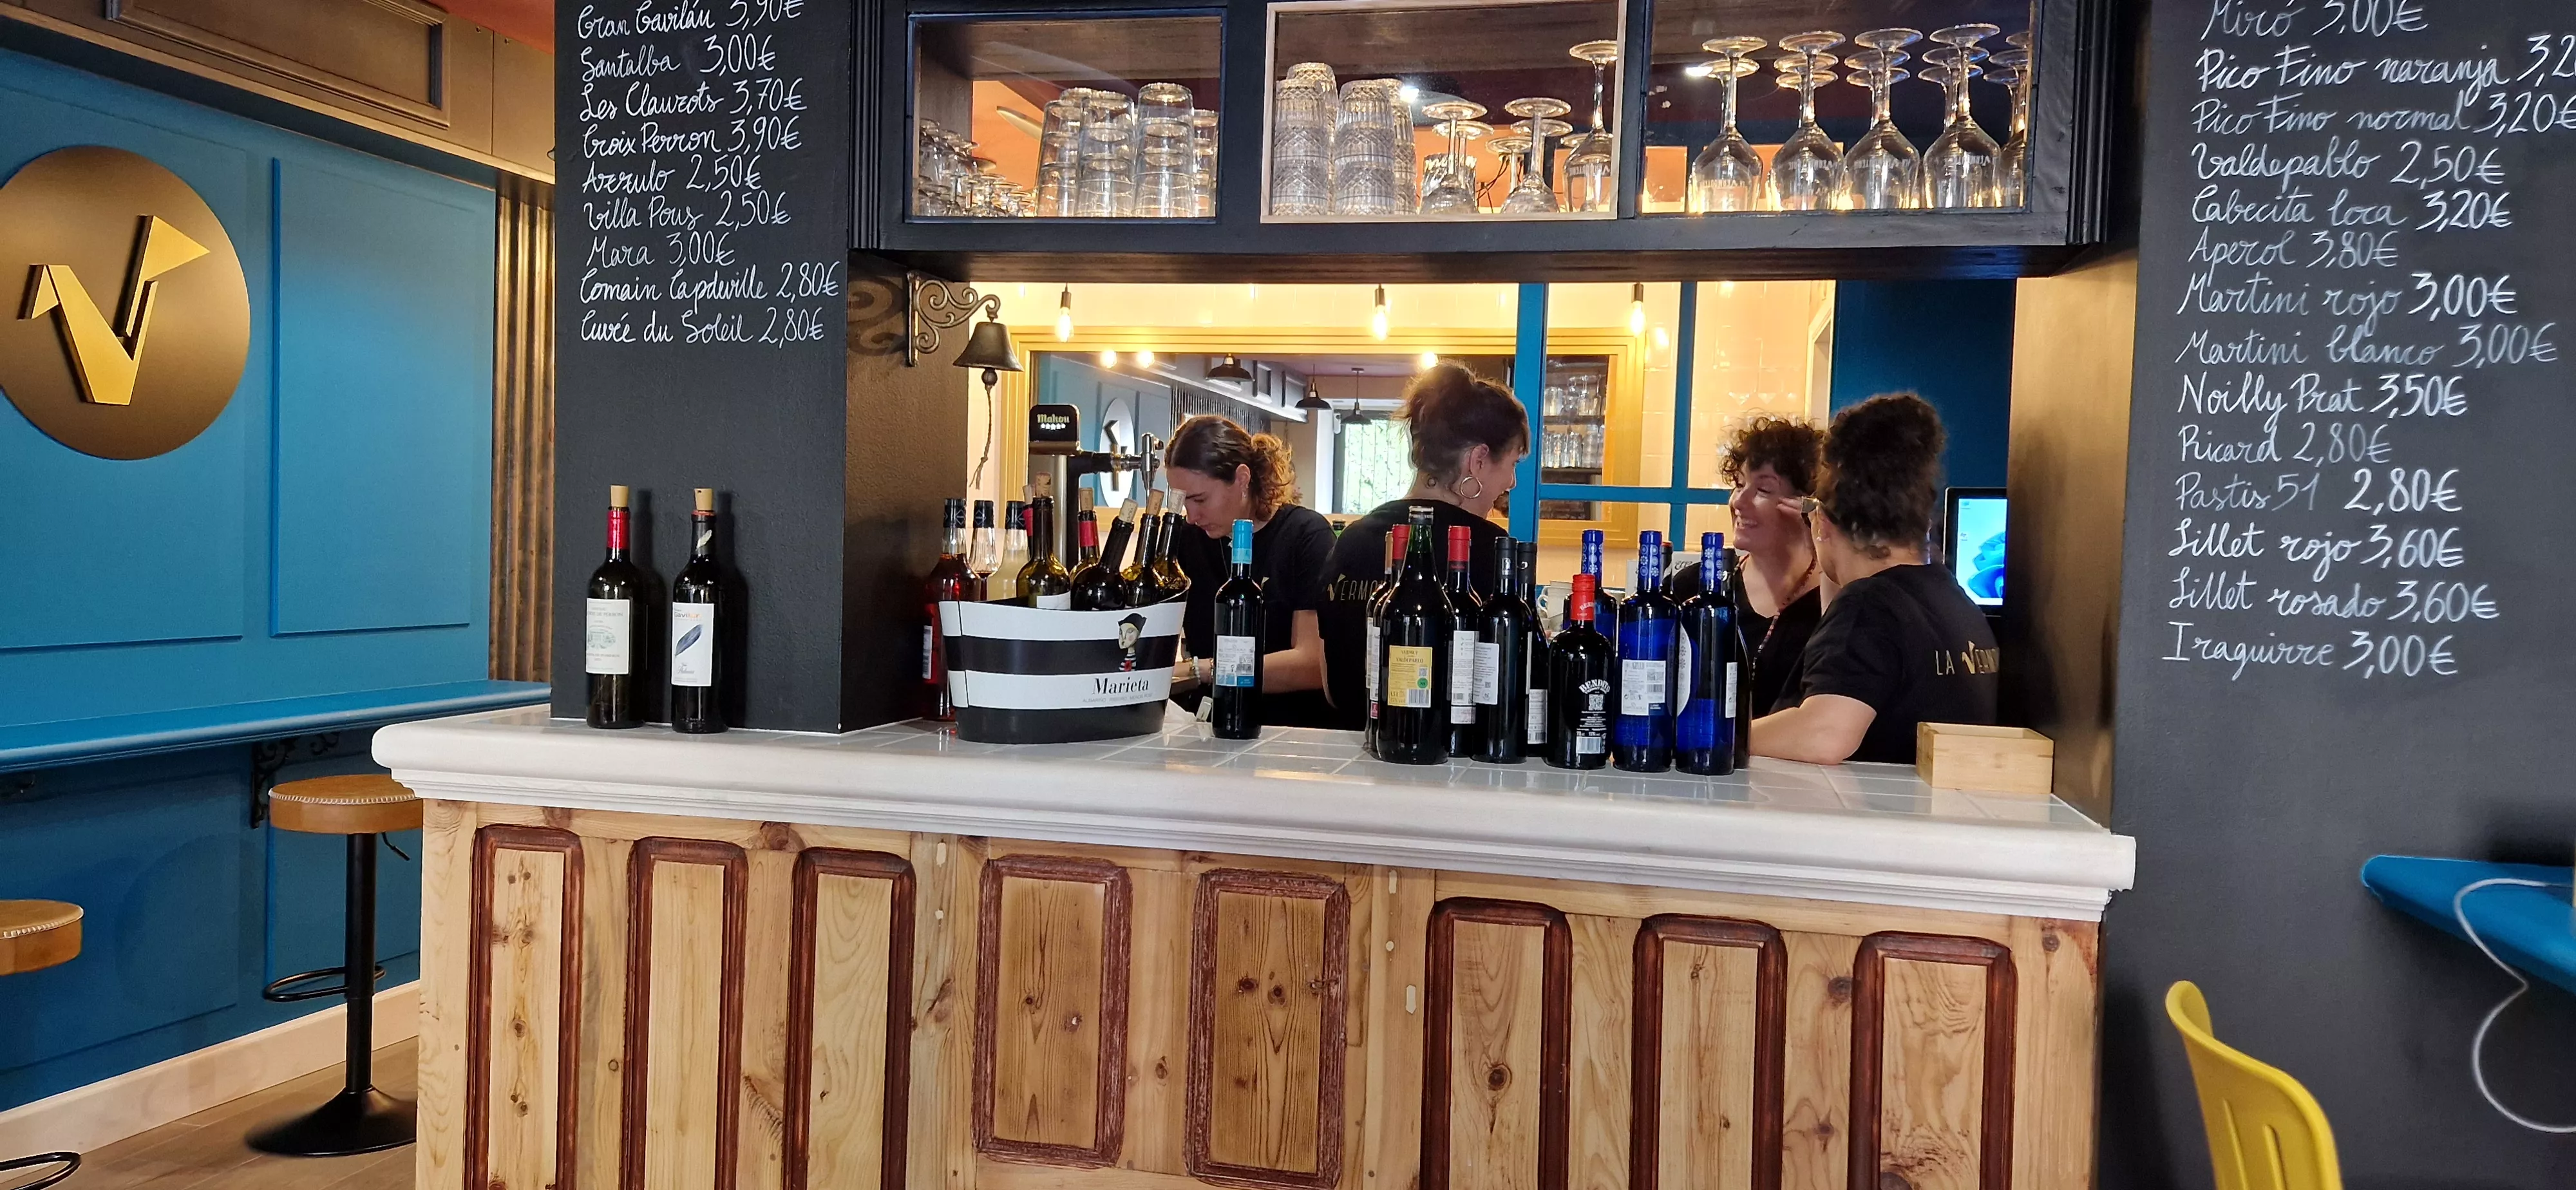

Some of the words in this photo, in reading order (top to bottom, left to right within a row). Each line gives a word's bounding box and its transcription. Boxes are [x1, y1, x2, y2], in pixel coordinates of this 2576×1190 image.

[2313, 0, 2429, 37] 3,00€
[581, 44, 681, 82] Santalba
[699, 33, 776, 77] 3,00€
[2195, 48, 2271, 93] Pico
[2274, 44, 2368, 87] Fino
[2374, 45, 2512, 107] naranja
[2516, 33, 2576, 88] 3,2
[580, 82, 618, 122] Les
[729, 77, 807, 116] 3,70€
[2190, 99, 2262, 135] Pico
[2256, 93, 2337, 134] Fino
[2346, 90, 2472, 131] normal
[2473, 91, 2576, 138] 3,20€
[641, 122, 721, 153] Perron
[728, 115, 802, 155] 3,90€
[686, 155, 762, 192] 2,50€
[2190, 135, 2382, 192] Valdepablo
[2391, 141, 2506, 189] 2,50€
[583, 197, 641, 231] Villa
[715, 190, 791, 231] 2,50€
[2192, 184, 2315, 225] Cabecita
[2327, 189, 2409, 227] loca
[2416, 190, 2513, 232] 3,20€
[586, 236, 655, 268] Mara
[666, 231, 735, 267] 3,00€
[2188, 228, 2297, 288] Aperol
[2306, 229, 2399, 269] 3,80€
[669, 264, 768, 314] Capdeville
[776, 261, 841, 303] 2,80€
[2177, 270, 2310, 315] Martini
[2322, 281, 2404, 337] rojo
[2408, 272, 2517, 321] 3,00€
[643, 310, 674, 343] du
[681, 309, 753, 344] Soleil
[759, 307, 824, 349] 2,80€
[2175, 328, 2309, 365] Martini
[2326, 324, 2446, 366] blanco
[2452, 322, 2558, 369] 3,00€
[1037, 413, 1070, 423] Mahou
[2177, 371, 2288, 434] Noilly
[2289, 373, 2363, 413] Prat
[2369, 373, 2468, 420] 3,50€
[2177, 424, 2282, 463] Ricard
[2293, 422, 2392, 468] 2,80€
[2175, 471, 2271, 512] Pastis
[2271, 471, 2320, 512] 51
[2344, 468, 2463, 517] 2,80€
[2278, 531, 2362, 582] rojo
[2360, 525, 2465, 569] 3,60€
[2267, 583, 2388, 619] rosado
[2387, 580, 2500, 623] 3,60€
[1935, 650, 1955, 675] LA
[2342, 630, 2458, 678] 3,00€
[1092, 676, 1149, 695] Marieta
[1579, 679, 1610, 694] BENDITO
